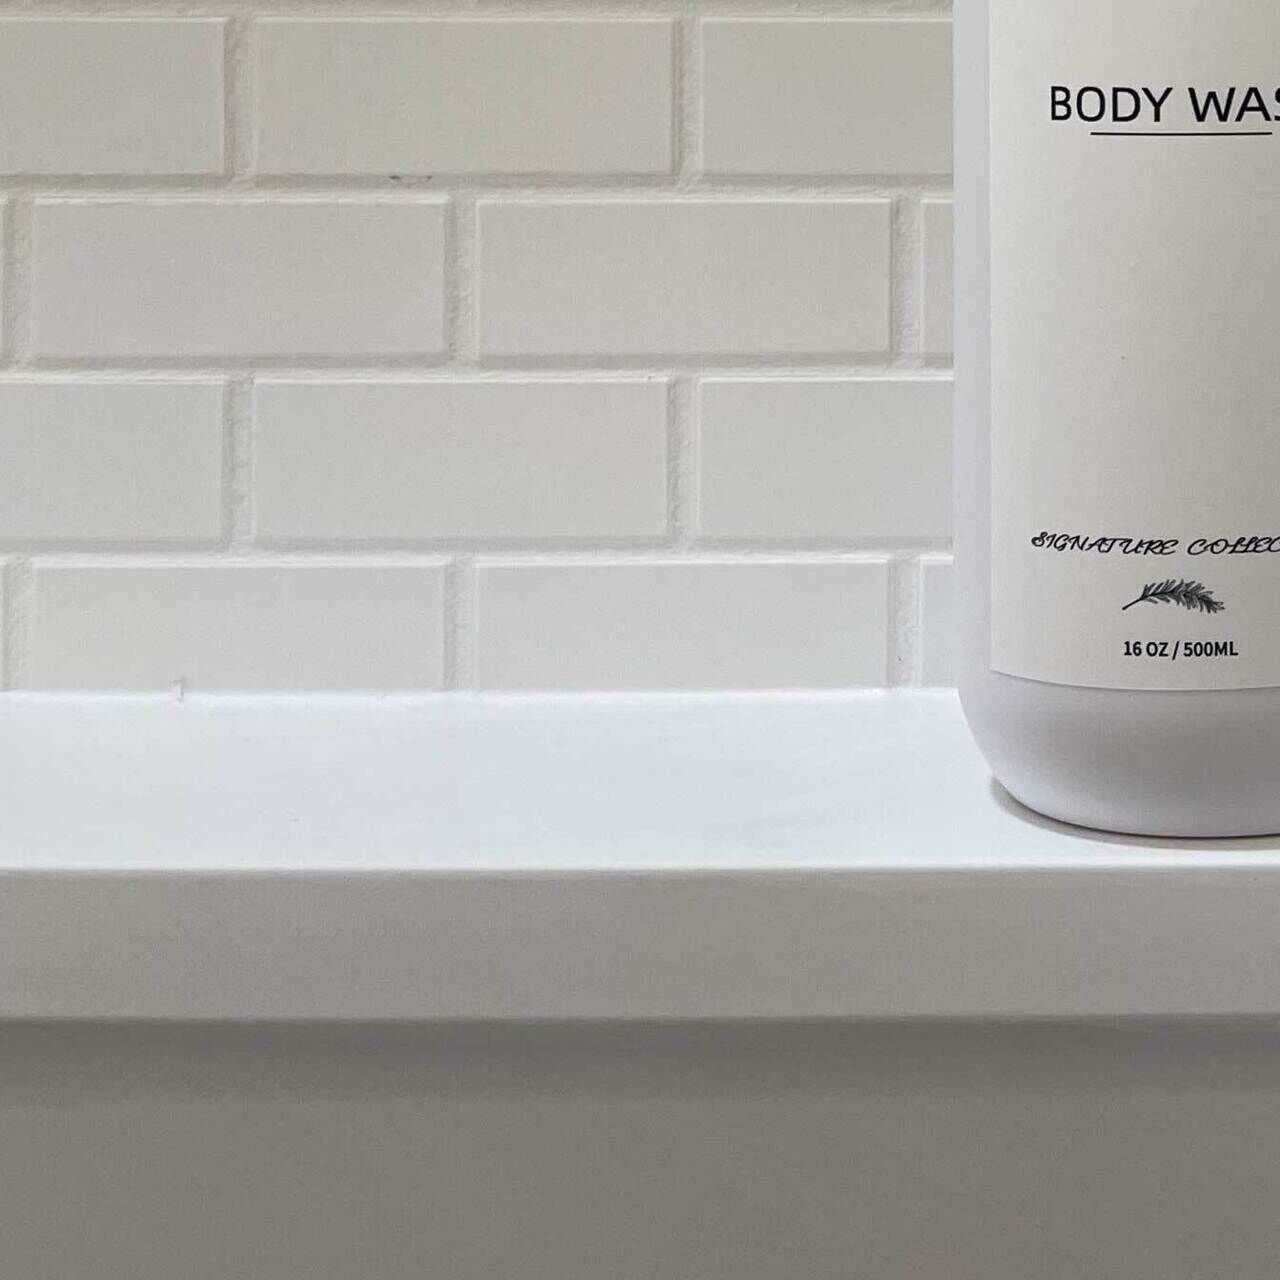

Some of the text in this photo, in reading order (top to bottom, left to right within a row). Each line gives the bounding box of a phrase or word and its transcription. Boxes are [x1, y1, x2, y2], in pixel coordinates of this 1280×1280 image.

[1050, 85, 1174, 123] BODY
[1030, 531, 1180, 556] SIGNATURE
[1123, 640, 1143, 657] 16
[1145, 641, 1170, 658] OZ
[1182, 640, 1239, 658] 500ML
